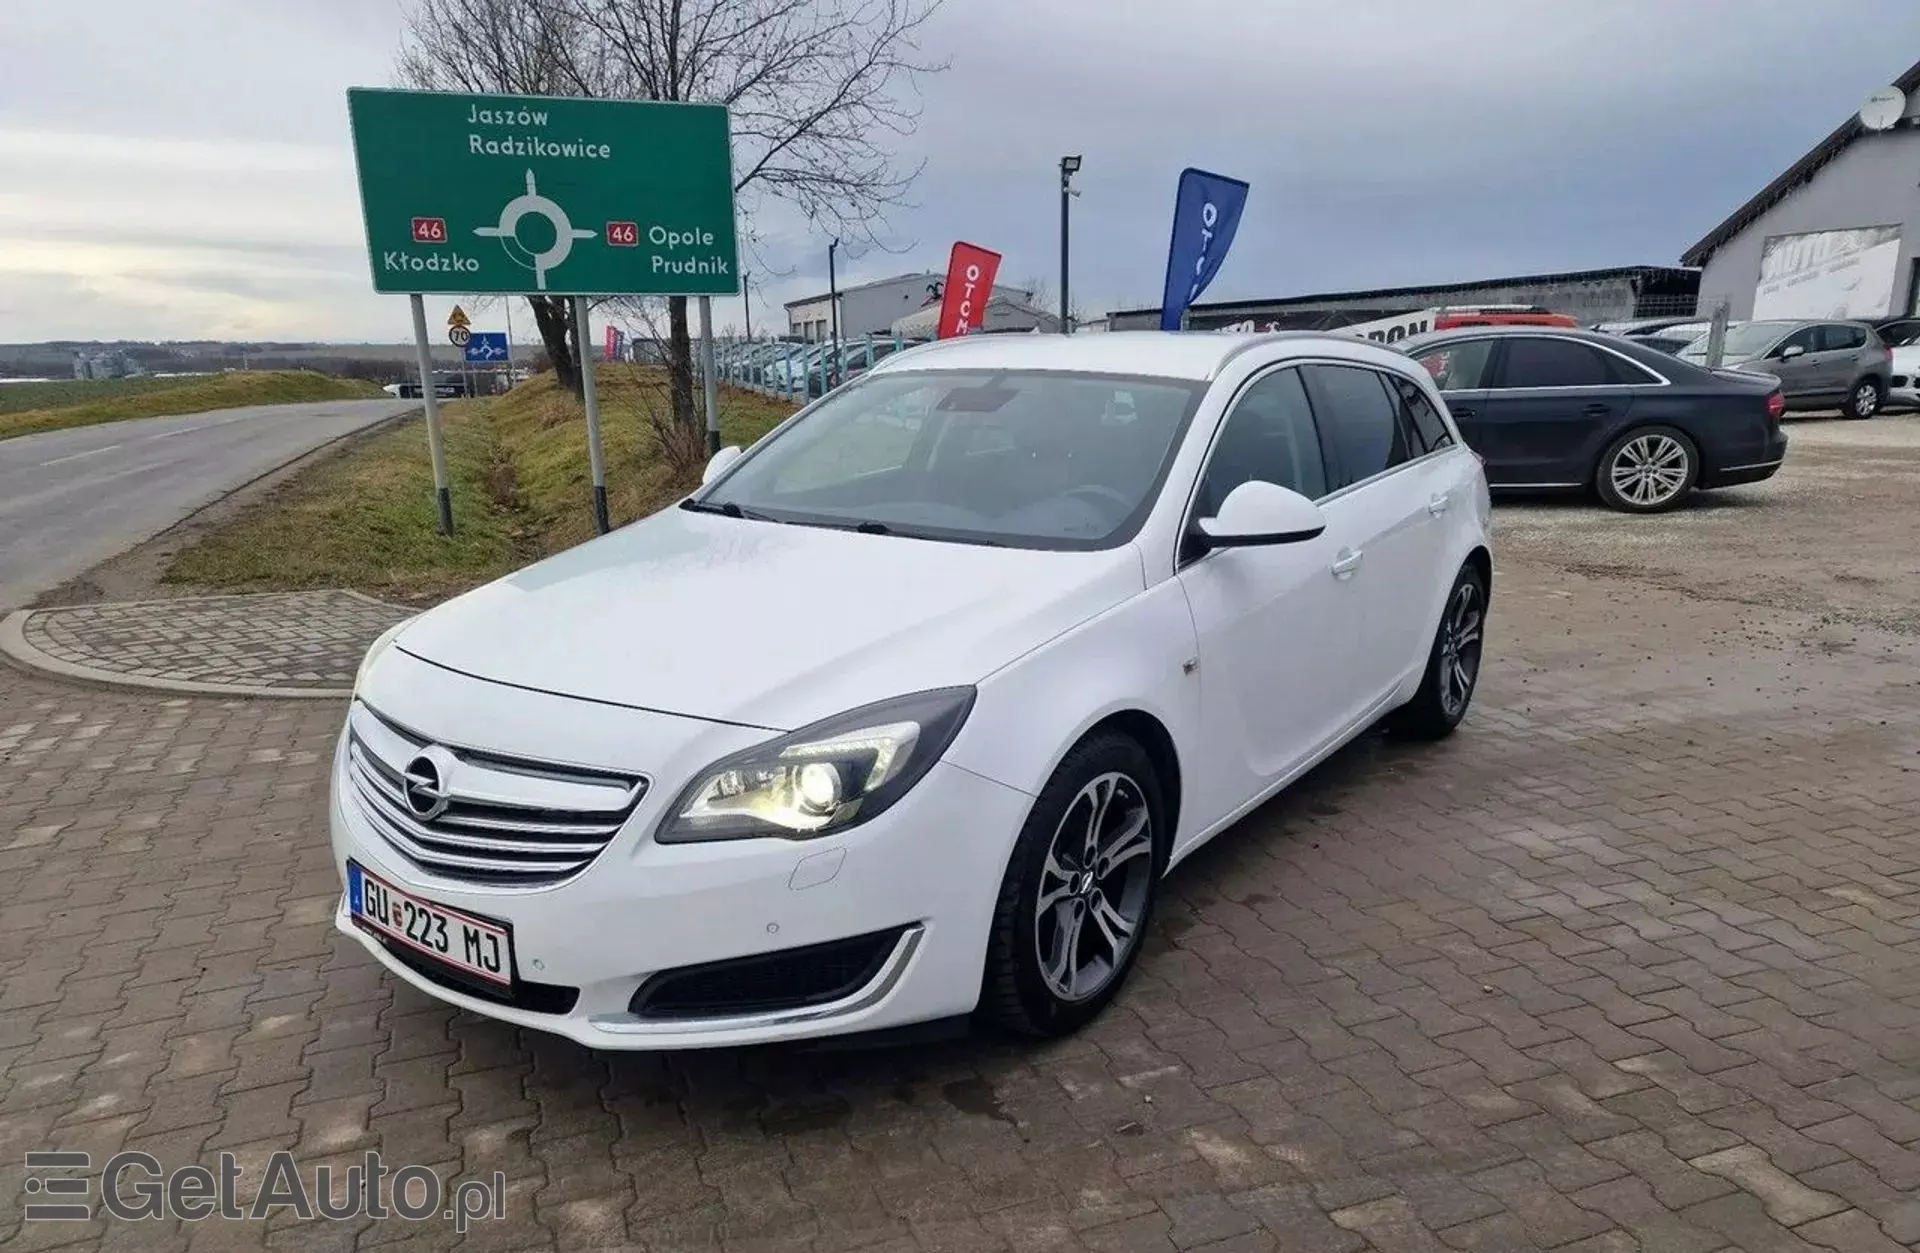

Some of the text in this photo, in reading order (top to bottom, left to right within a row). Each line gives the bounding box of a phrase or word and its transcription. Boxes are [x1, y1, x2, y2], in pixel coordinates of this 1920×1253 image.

[468, 103, 548, 126] Jaszów
[469, 134, 611, 158] Radzikowice
[418, 222, 442, 239] 46
[612, 226, 714, 250] 46 Opole
[383, 251, 480, 272] Kłodzko
[651, 256, 729, 274] Prudnik
[452, 330, 468, 342] 70
[365, 878, 501, 973] GU 223 MJ
